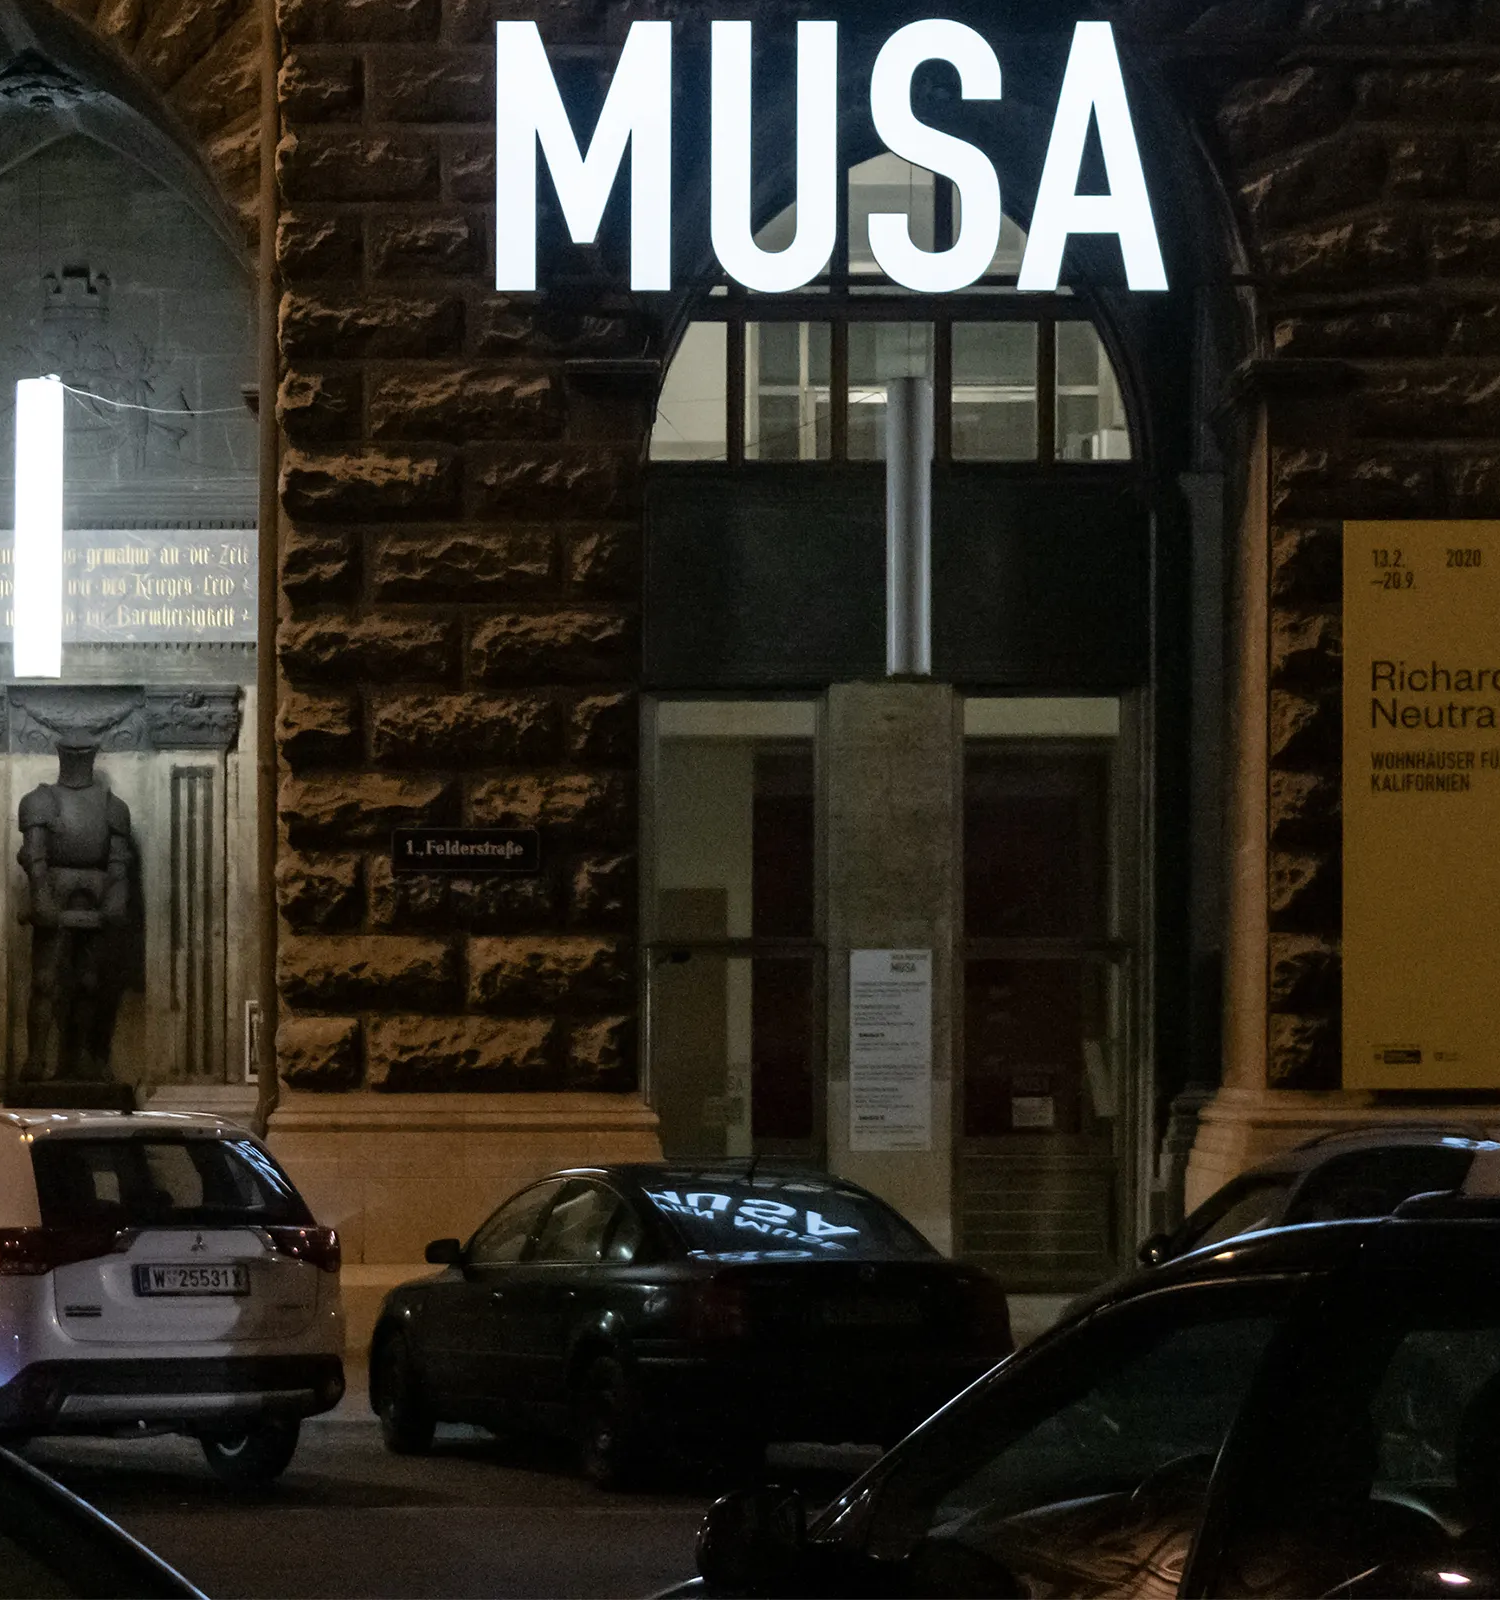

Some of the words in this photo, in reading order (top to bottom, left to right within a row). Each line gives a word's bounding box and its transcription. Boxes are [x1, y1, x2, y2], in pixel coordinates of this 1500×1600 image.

[496, 18, 1169, 293] MUSA
[159, 547, 179, 565] an
[1446, 550, 1481, 568] 2020
[1371, 697, 1496, 729] Neutra
[1371, 750, 1475, 770] WOHNHÄUSER
[1371, 773, 1470, 793] KALIFORNIEN
[153, 1269, 164, 1288] W
